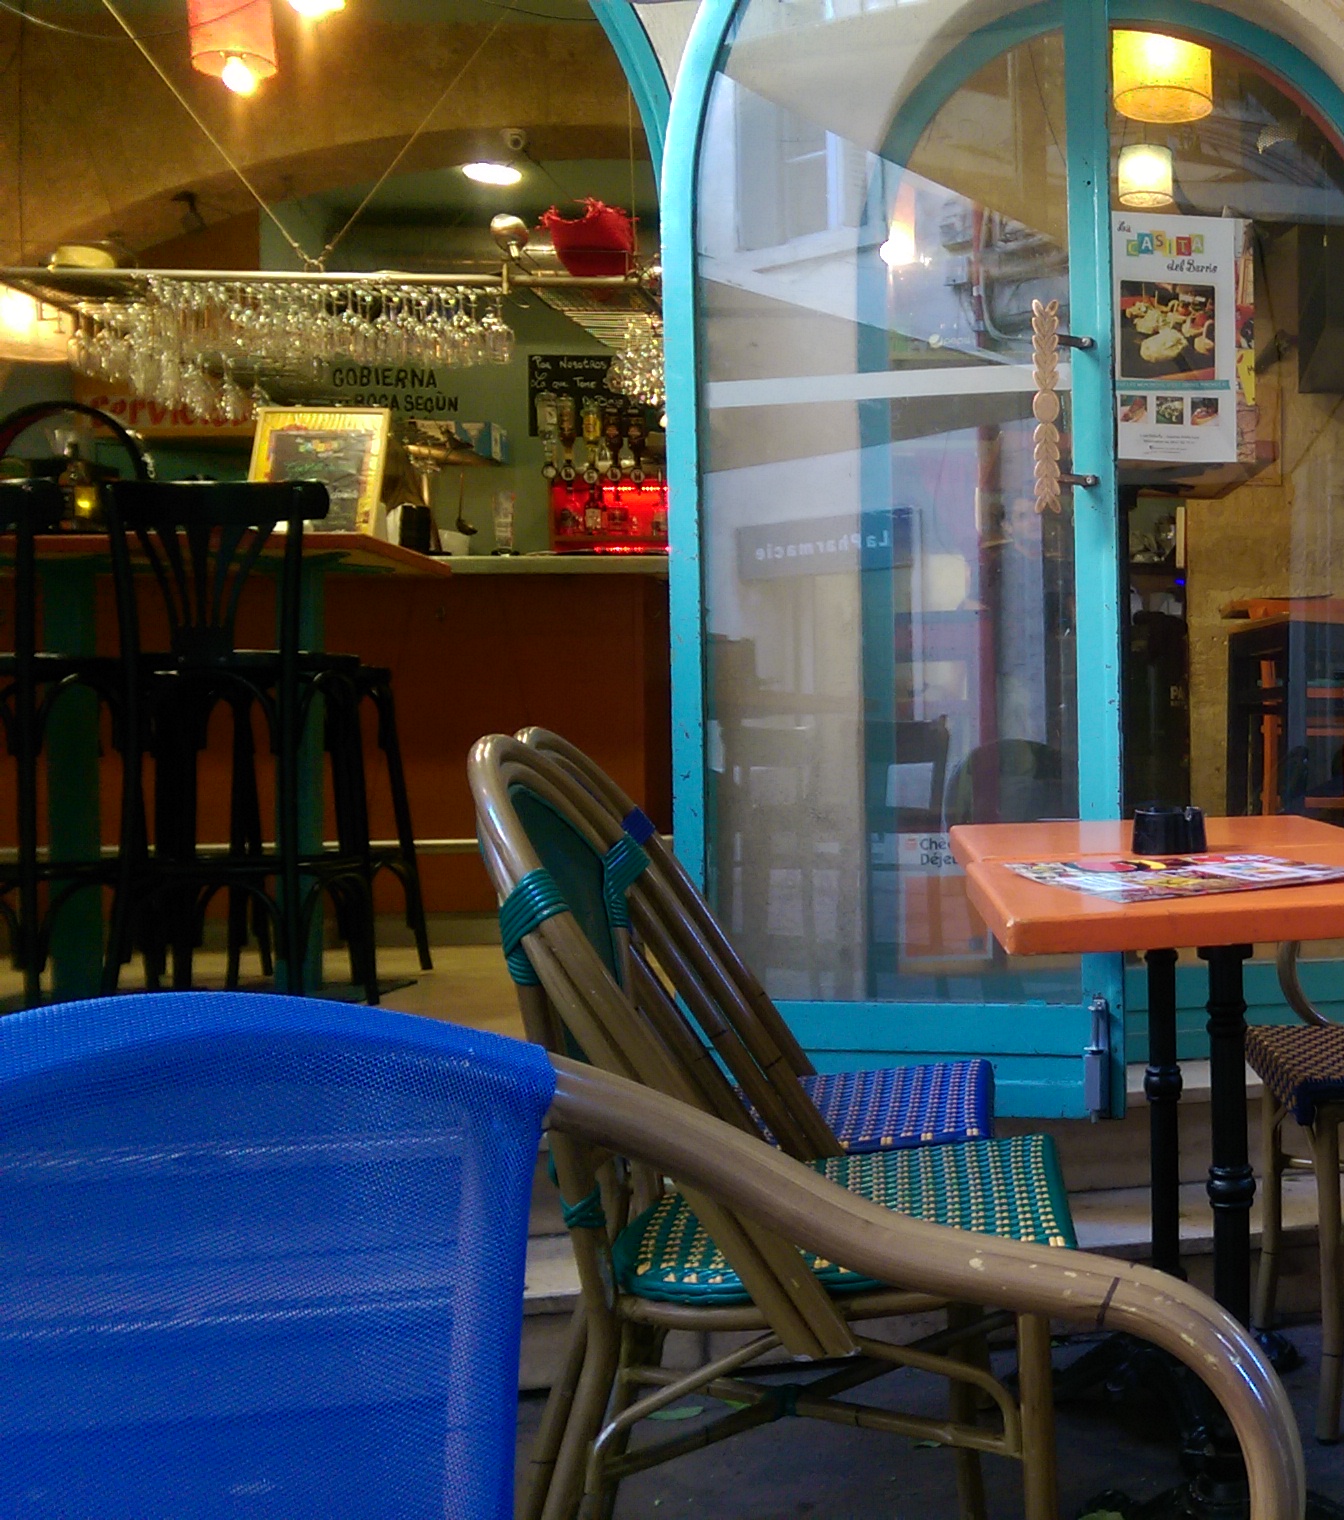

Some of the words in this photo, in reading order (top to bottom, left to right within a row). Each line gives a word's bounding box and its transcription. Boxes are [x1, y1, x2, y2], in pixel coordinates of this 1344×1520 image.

[1127, 231, 1204, 256] CASITA
[332, 366, 437, 389] GOBIERNA
[919, 837, 950, 851] Chè
